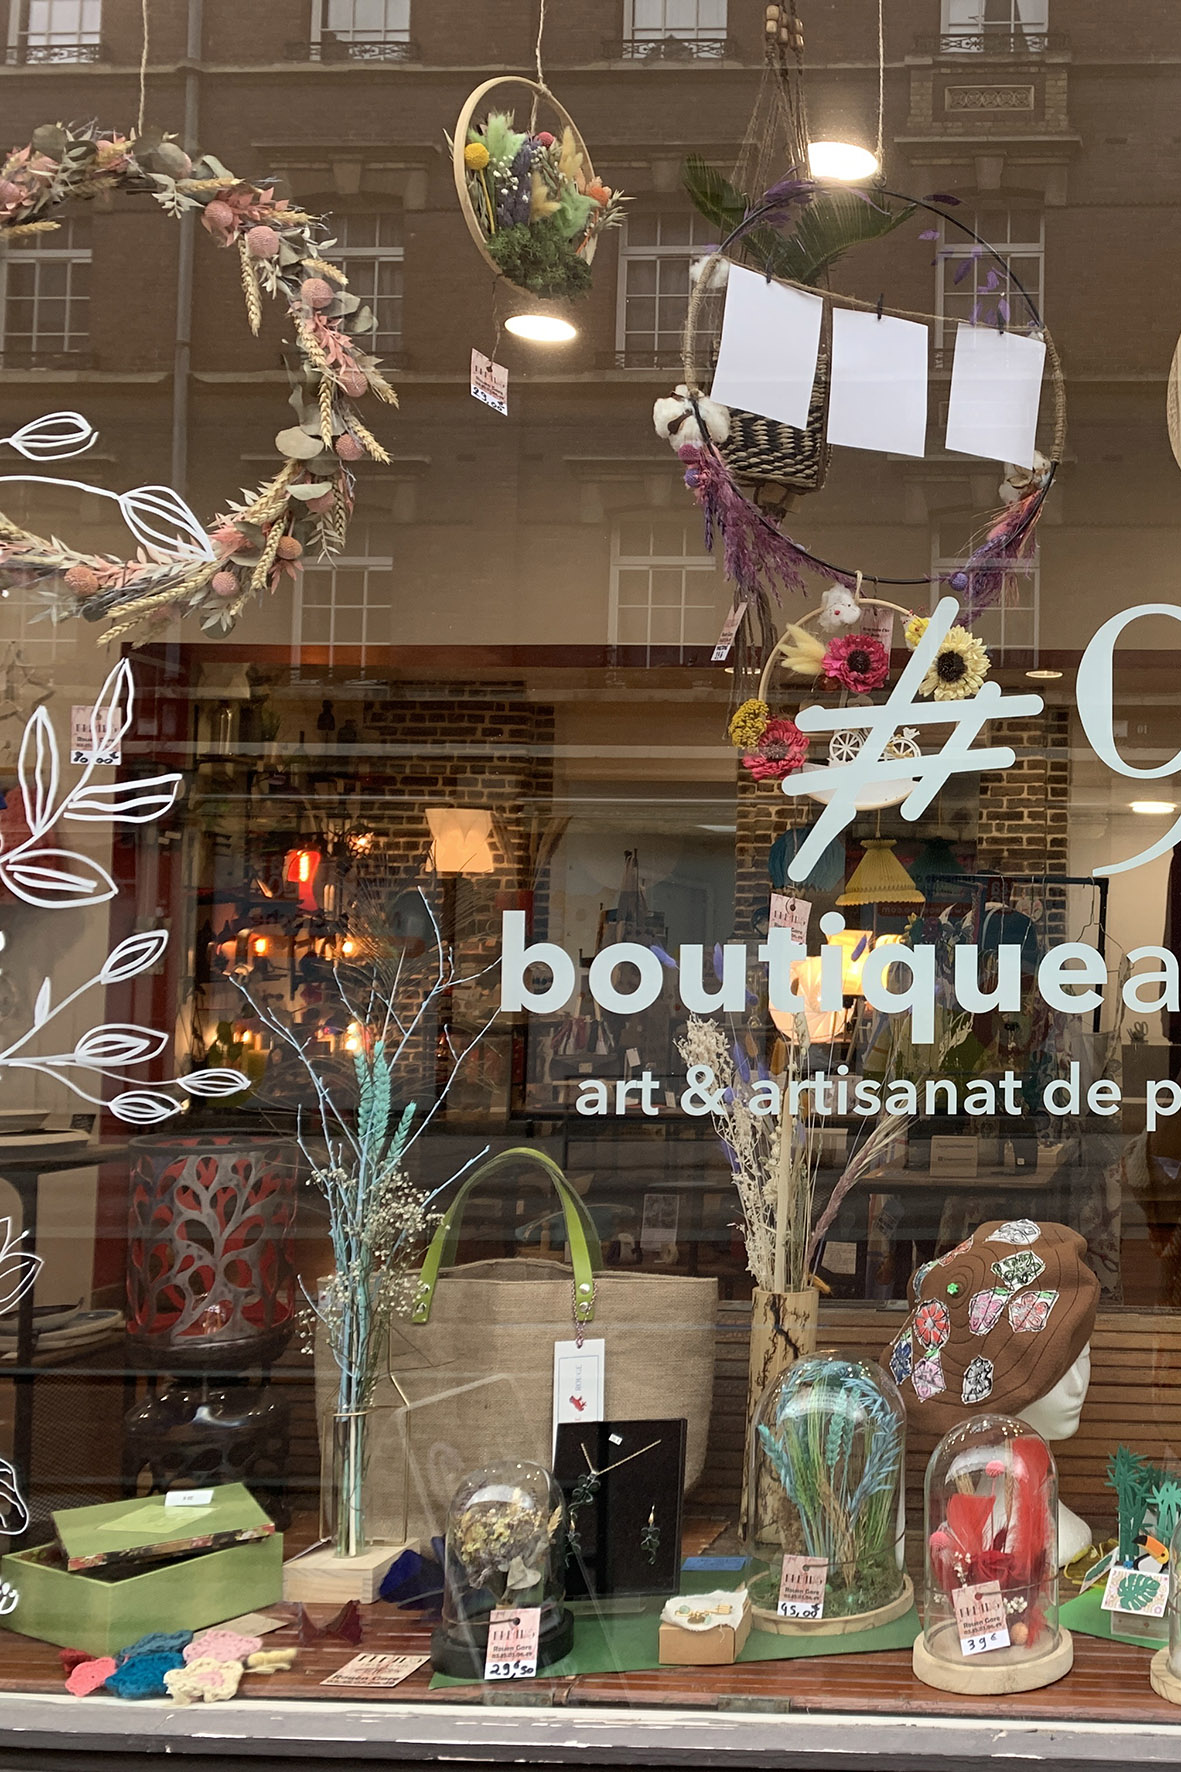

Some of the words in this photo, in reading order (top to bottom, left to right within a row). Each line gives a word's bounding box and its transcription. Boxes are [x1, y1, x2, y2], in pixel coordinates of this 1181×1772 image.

[576, 1070, 660, 1117] art
[680, 1063, 740, 1117] &
[749, 1062, 1023, 1118] artisanat
[1044, 1062, 1123, 1118] de
